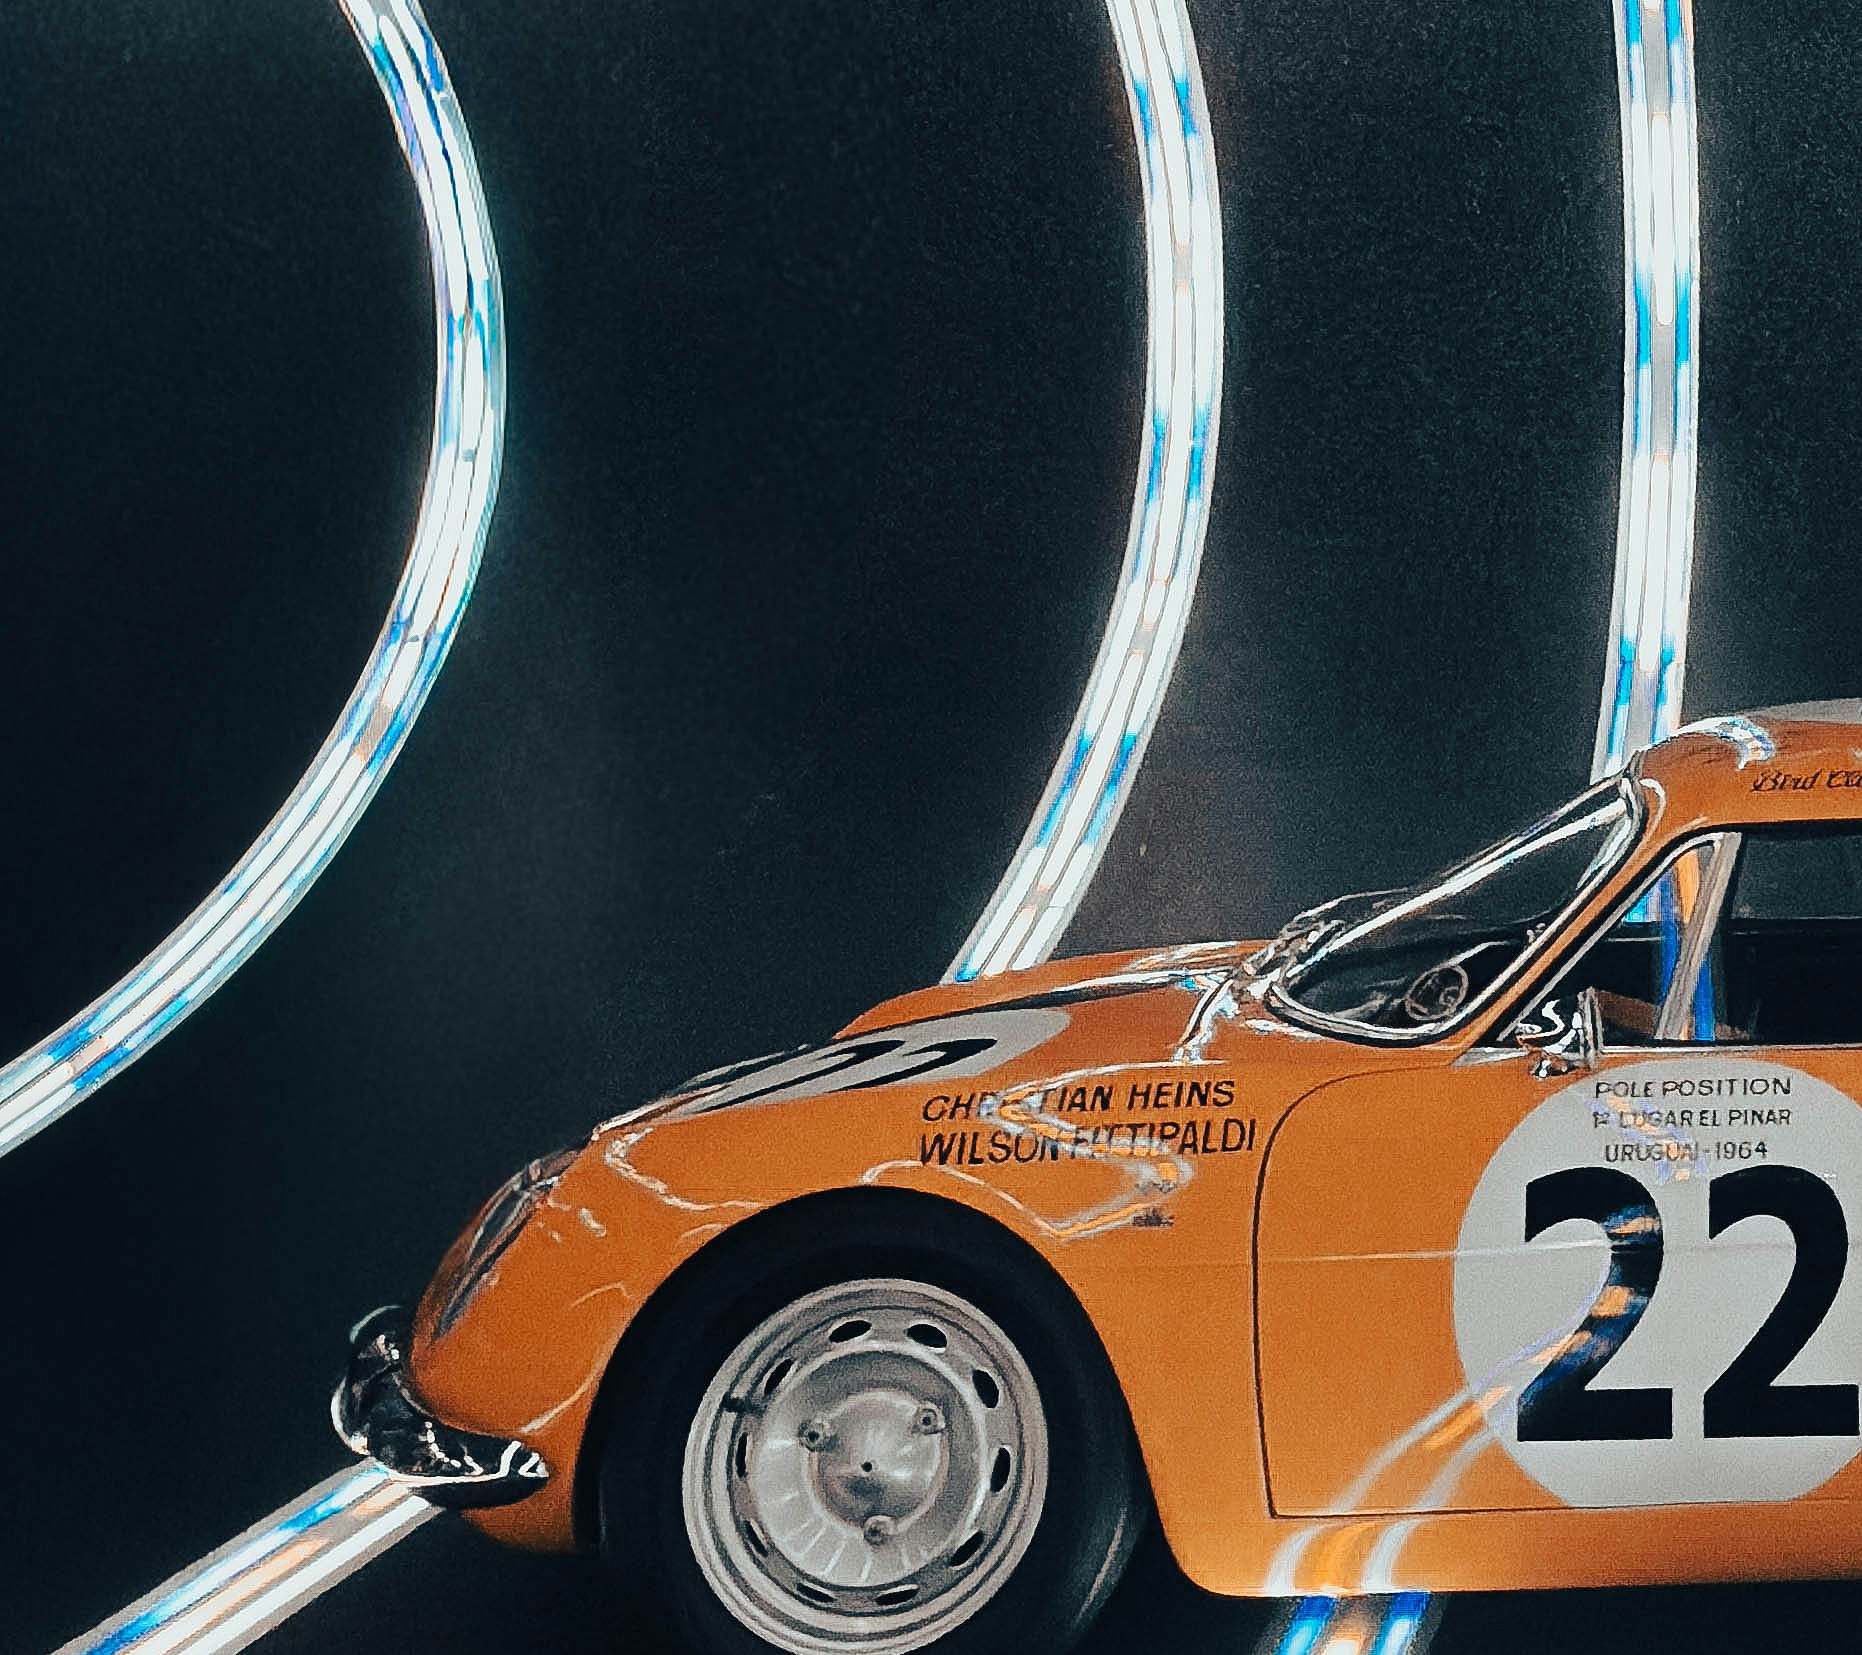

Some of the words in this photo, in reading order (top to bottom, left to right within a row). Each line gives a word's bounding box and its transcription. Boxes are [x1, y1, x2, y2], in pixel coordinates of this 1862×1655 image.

[921, 1086, 1114, 1122] CHRTIAN
[1127, 1080, 1236, 1111] HEINS
[1594, 1080, 1654, 1099] POLE
[1662, 1077, 1792, 1097] POSITION
[1620, 1109, 1693, 1128] LUGAR
[1699, 1109, 1721, 1127] EL
[1728, 1109, 1792, 1126] PINAR
[919, 1131, 1060, 1167] WILSON
[1517, 1164, 1860, 1442] 22
